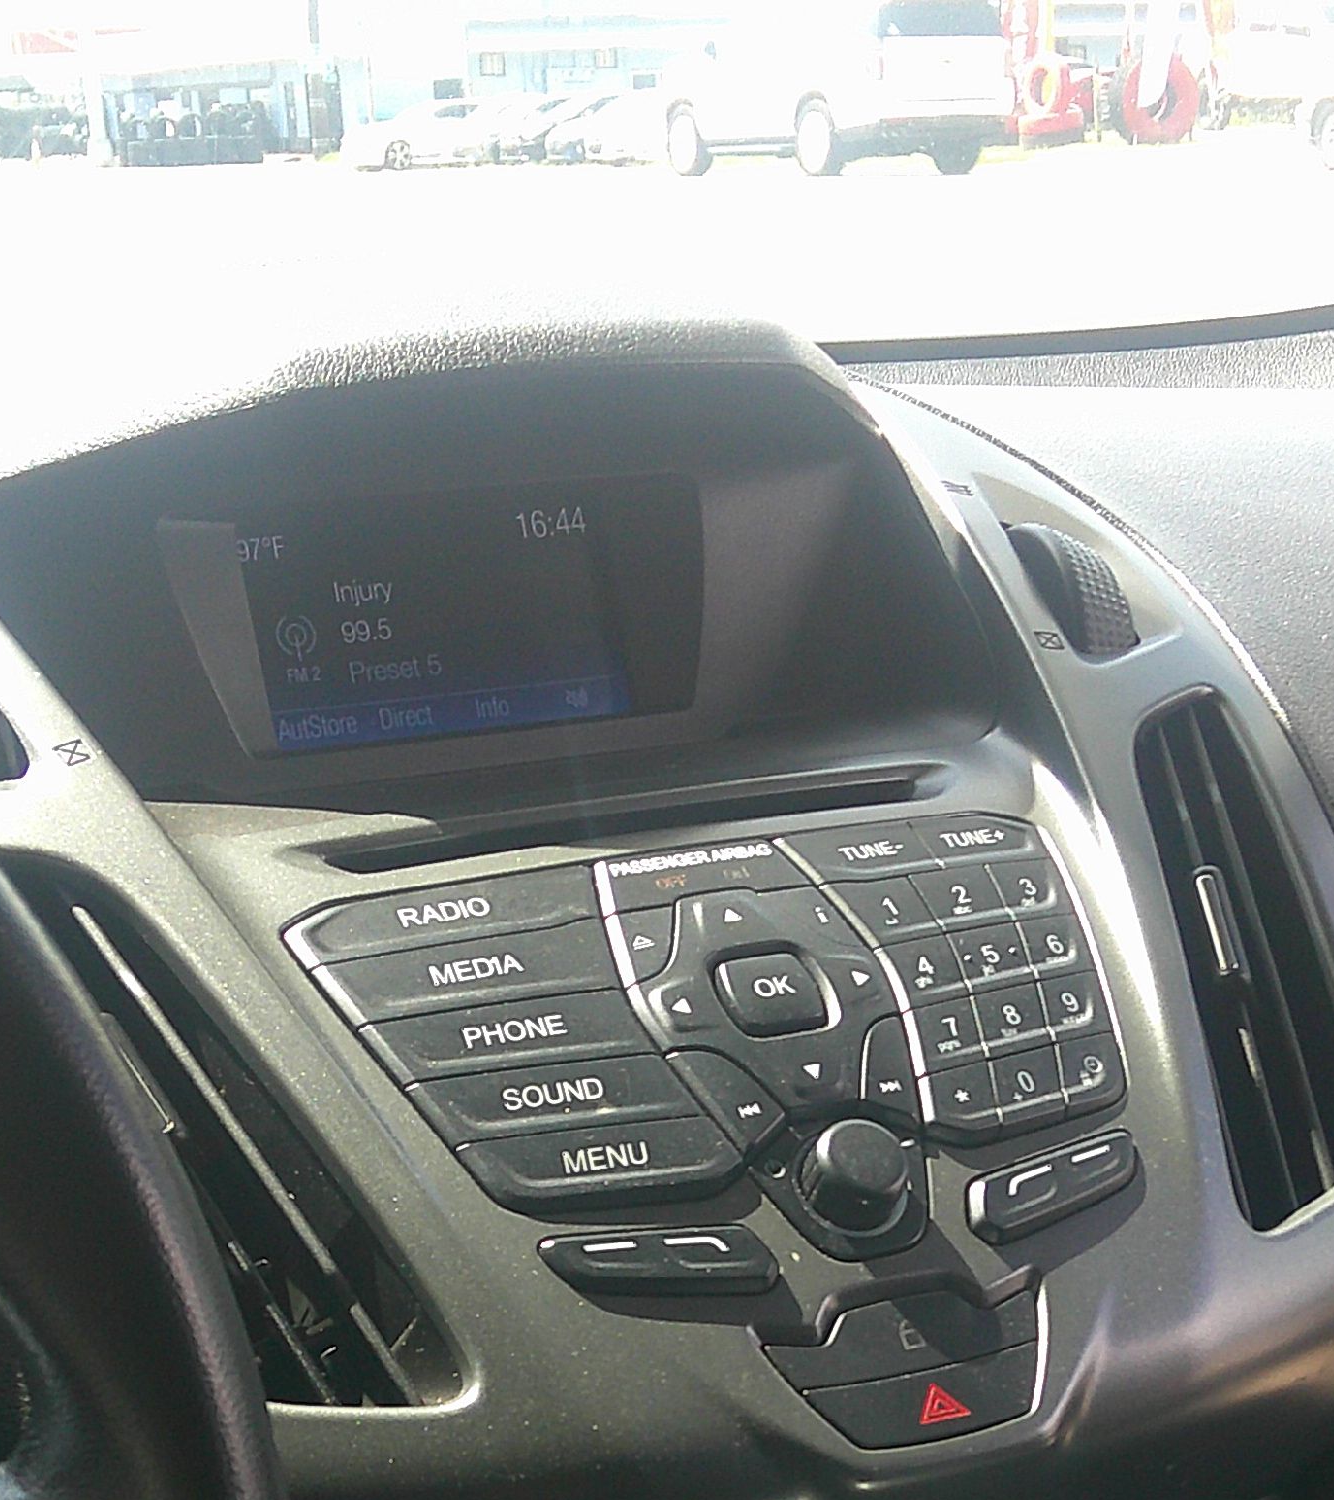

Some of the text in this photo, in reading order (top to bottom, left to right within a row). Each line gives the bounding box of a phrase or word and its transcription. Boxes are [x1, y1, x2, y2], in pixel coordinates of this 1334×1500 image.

[515, 506, 587, 538] 16:44
[333, 579, 392, 607] Injury
[341, 617, 392, 644] 99.5
[349, 654, 443, 684] Preset 5
[278, 696, 511, 743] AutStore Direct Info
[838, 841, 905, 862] TUNE-
[940, 829, 1005, 850] TUNE+
[608, 849, 712, 878] PASSENGER
[712, 842, 774, 862] AIRBAG
[951, 885, 972, 904] 2
[1018, 878, 1038, 896] 3
[396, 897, 492, 929] RADIO
[882, 897, 899, 916] 1
[979, 943, 1000, 964] 5
[1045, 933, 1065, 954] 6
[427, 953, 525, 988] MEDIA
[918, 956, 935, 975] 4
[753, 974, 797, 1000] OK
[1061, 991, 1079, 1013] 9
[940, 1016, 959, 1037] 7
[1002, 1004, 1022, 1026] 8
[462, 1013, 569, 1050] PHONE
[1017, 1069, 1036, 1094] 0
[502, 1077, 604, 1112] SOUND
[562, 1140, 650, 1175] MENU
